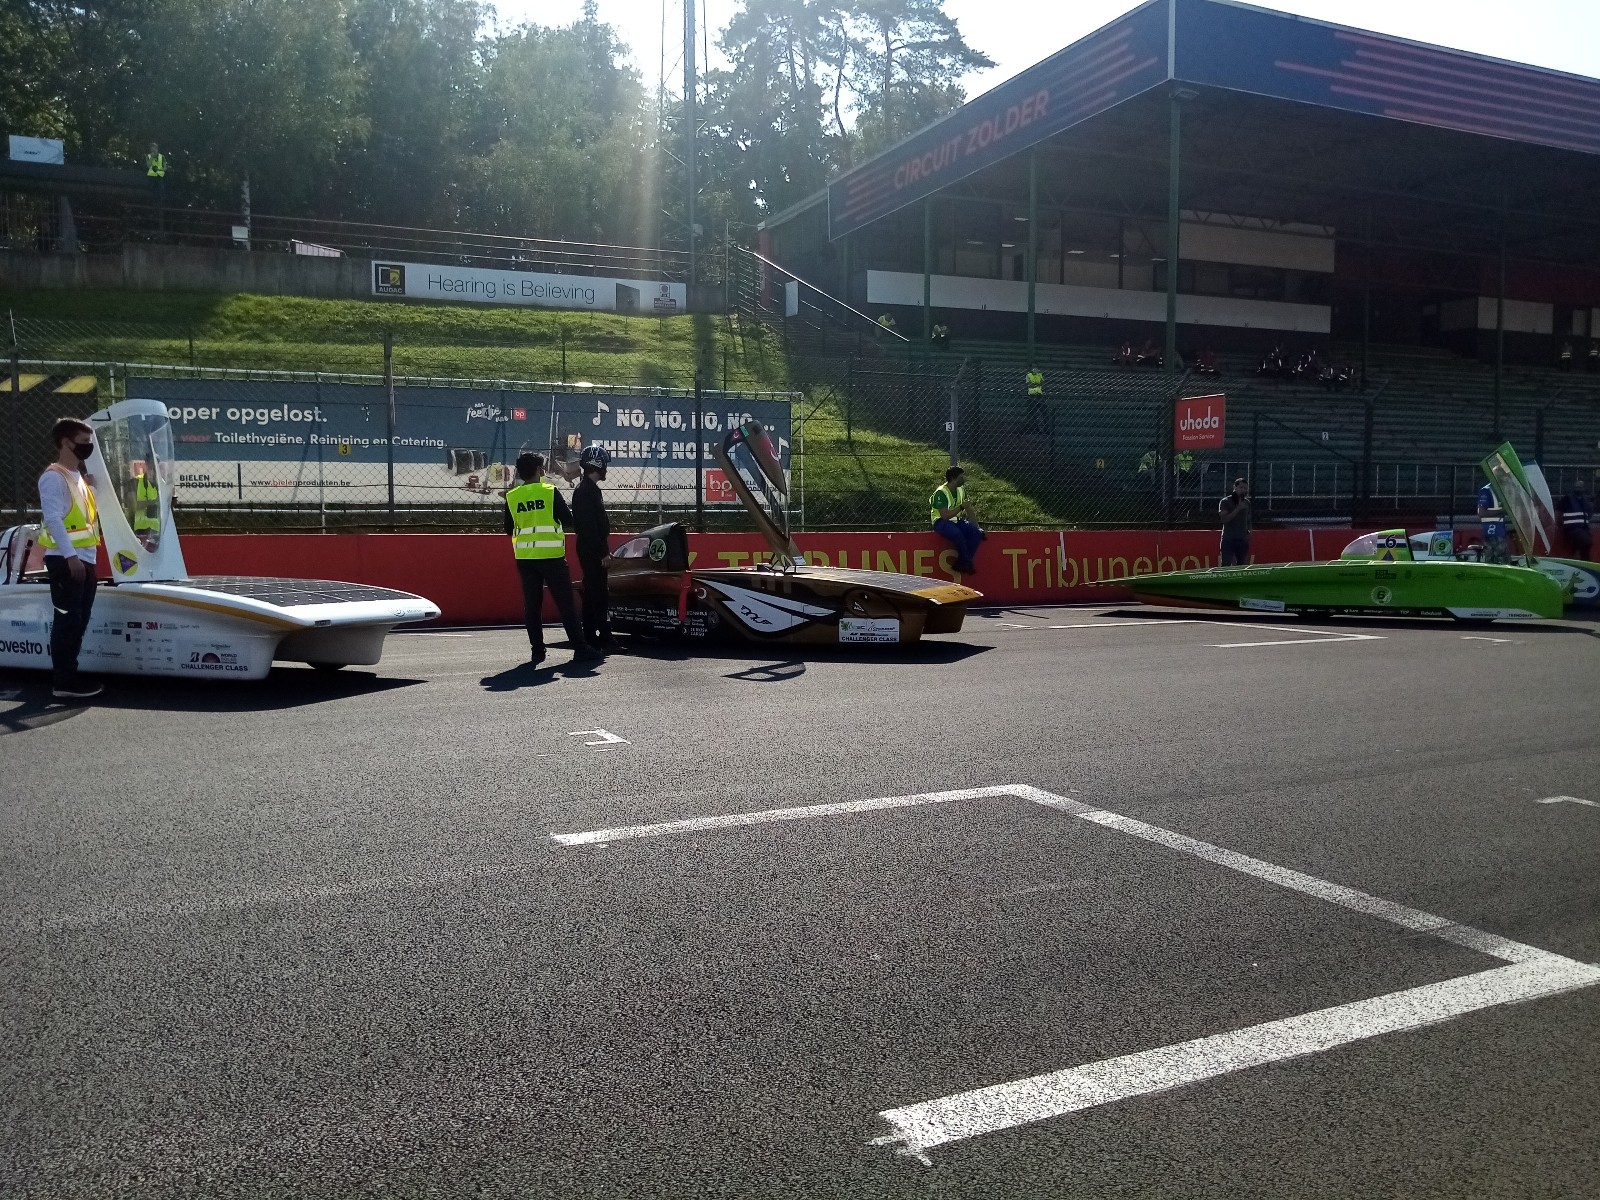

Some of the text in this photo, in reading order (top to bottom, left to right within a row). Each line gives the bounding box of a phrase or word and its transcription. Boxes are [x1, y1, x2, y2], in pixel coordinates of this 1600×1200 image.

[894, 89, 1049, 189] CIRCUIT ZOLDER
[428, 273, 595, 304] Hearing is Believing
[226, 404, 328, 425] opgelost.
[616, 408, 650, 430] NO,
[655, 410, 687, 432] NO,
[1180, 405, 1219, 431] uhoda
[310, 434, 369, 449] Reiniging
[591, 439, 667, 460] THERE'S
[672, 441, 697, 460] NO
[179, 474, 210, 482] BIELEN
[250, 479, 351, 488] www.bielenprodukten.be
[709, 474, 733, 498] bp
[516, 499, 545, 513] ARB
[1385, 534, 1396, 549] 6
[1438, 542, 1446, 551] 9
[650, 544, 665, 557] 34
[718, 551, 961, 586] UNES
[1003, 545, 1256, 588] Tribuneb
[1377, 590, 1386, 600] 6
[145, 621, 158, 630] 3M
[0, 640, 42, 655] ovestro
[181, 663, 248, 672] CHALLENGER CLASS
